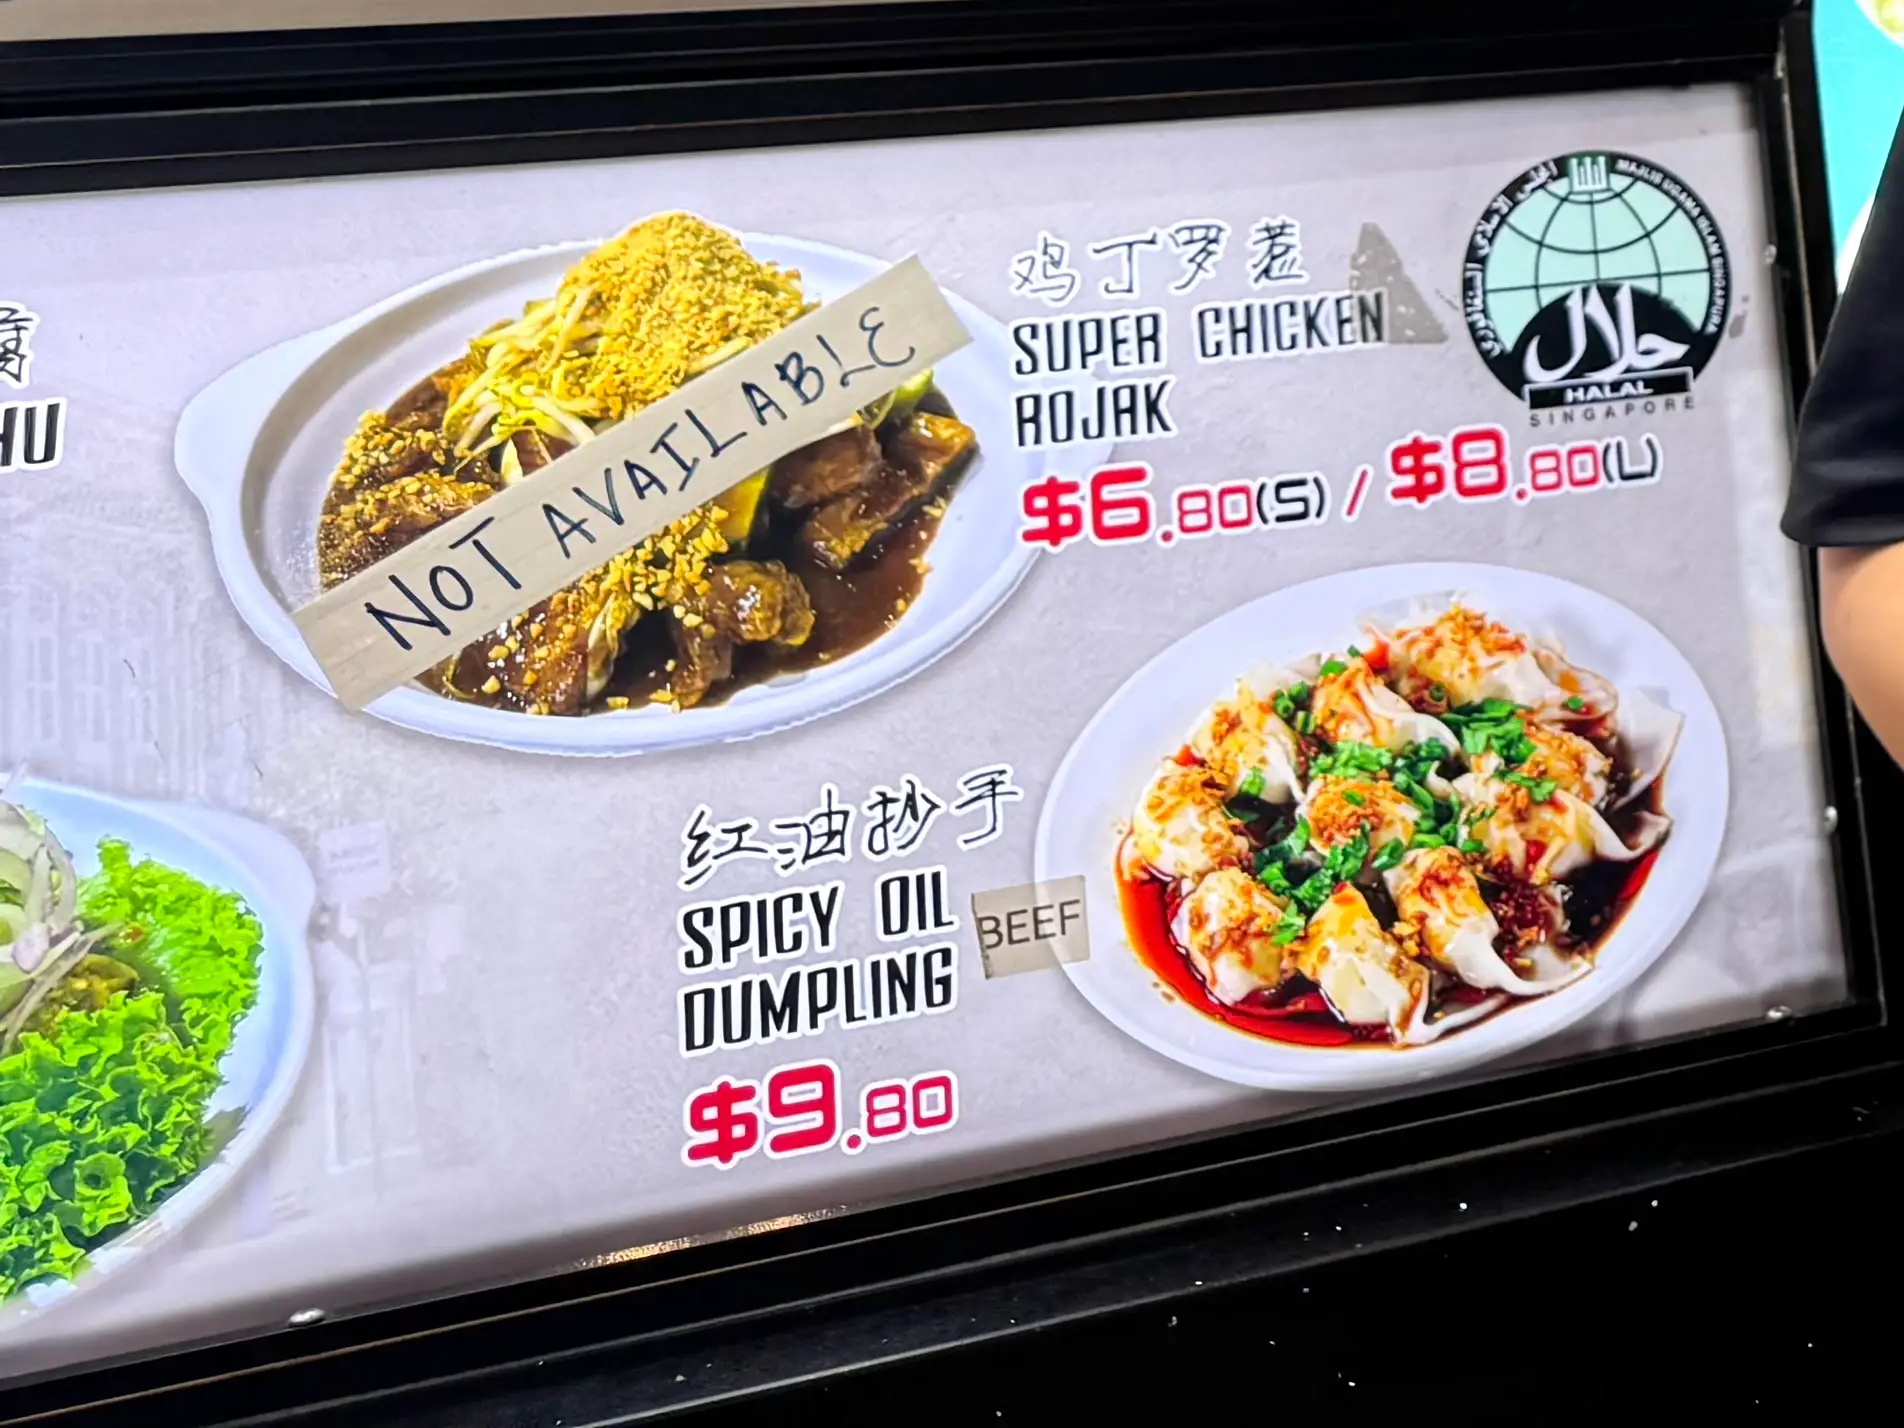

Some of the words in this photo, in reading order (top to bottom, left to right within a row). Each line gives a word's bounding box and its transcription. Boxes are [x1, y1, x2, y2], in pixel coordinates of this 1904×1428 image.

[1012, 217, 1307, 304] 鸡丁罗惹
[1013, 313, 1164, 377] SUPER
[1199, 289, 1388, 359] CHICKEN
[1016, 379, 1174, 447] ROJAK
[1529, 396, 1695, 428] SINGAPORE
[1563, 380, 1654, 404] HALAL
[365, 514, 522, 652] NOT
[543, 305, 916, 560] AVAILABLE
[684, 768, 1022, 886] 红油抄手
[684, 886, 842, 970] SPICY
[882, 873, 954, 936] OIL
[977, 900, 1082, 951] BEEF
[684, 948, 954, 1053] DUMPLING
[687, 1062, 954, 1166] $9.80
